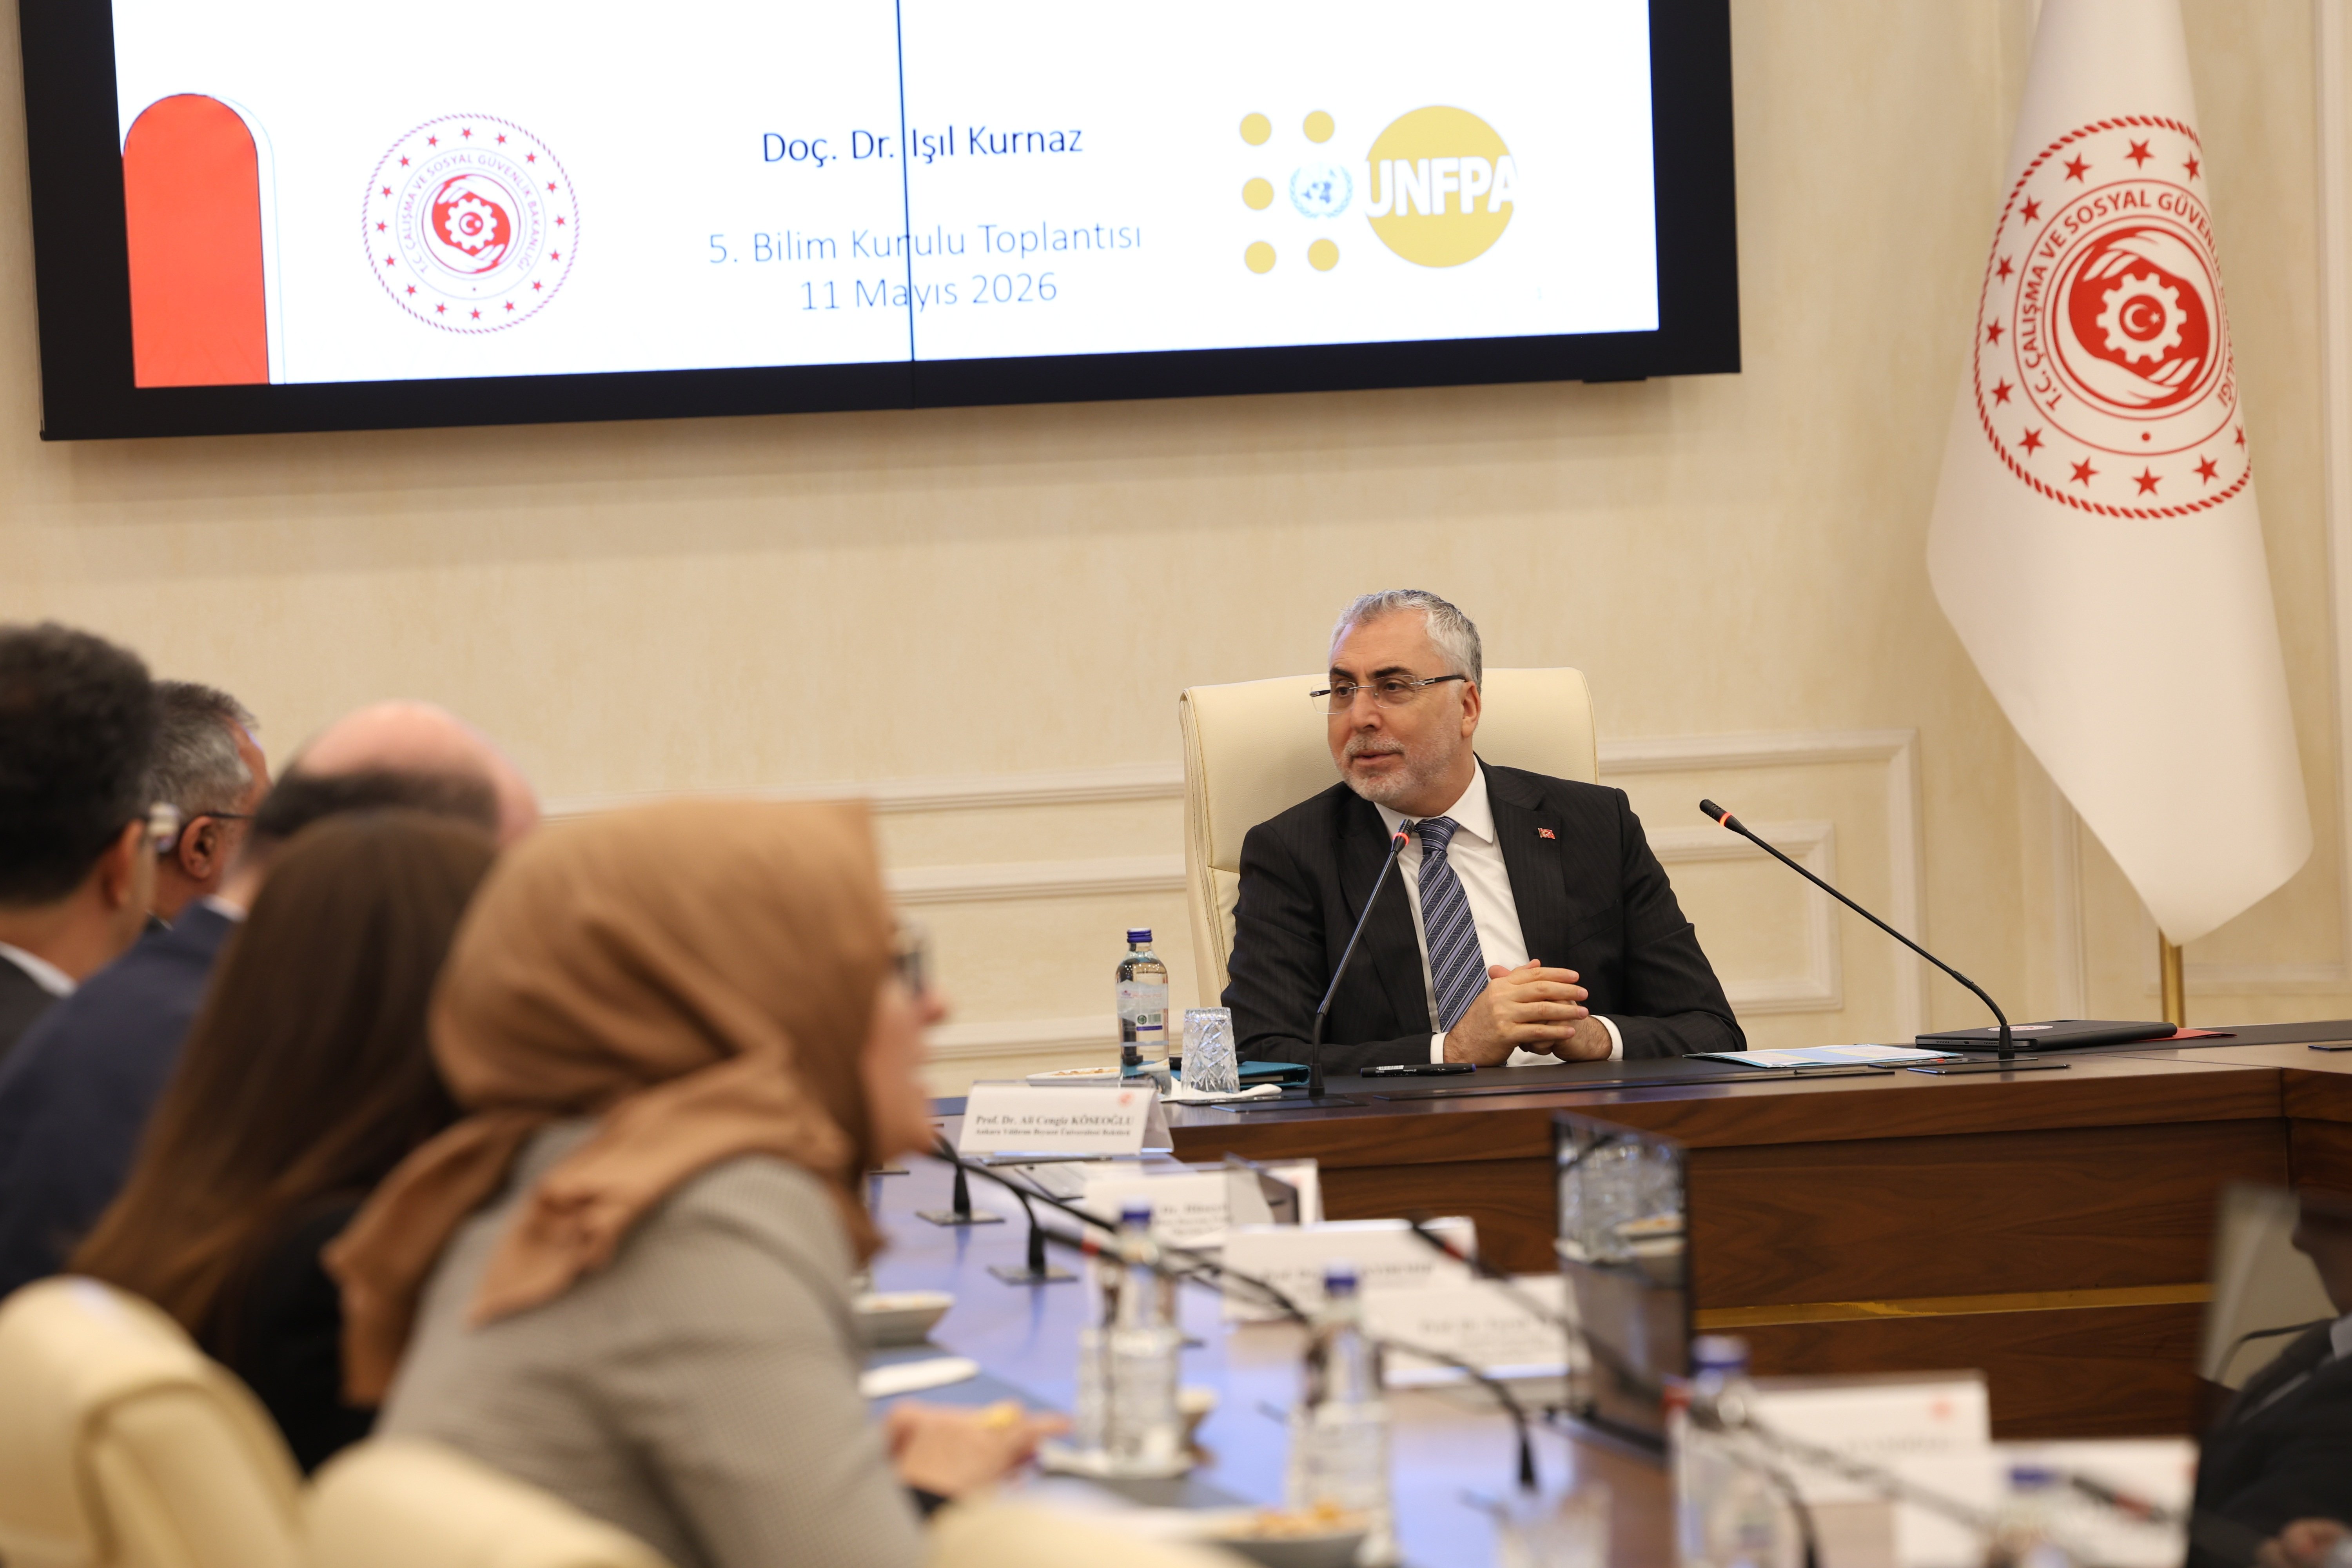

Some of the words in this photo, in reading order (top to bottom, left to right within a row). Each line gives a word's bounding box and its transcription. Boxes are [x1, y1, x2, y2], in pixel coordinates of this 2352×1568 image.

[763, 132, 837, 167] Doç.
[851, 130, 894, 159] Dr.
[913, 125, 955, 164] Işıl
[969, 125, 1084, 155] Kurnaz
[413, 174, 427, 190] VE
[426, 154, 472, 176] SOSYAL
[1363, 154, 1518, 218] UNFPA
[2064, 189, 2152, 235] SOSYAL
[709, 233, 738, 264] 5.
[754, 229, 837, 263] Bilim
[853, 225, 965, 258] Kurulu
[977, 220, 1141, 259] Toplantısı
[2040, 230, 2067, 258] VE
[800, 280, 840, 310] 11
[856, 279, 959, 313] Mayıs
[972, 271, 1058, 304] 2026
[2022, 266, 2048, 368] ÇALIŞMA
[2035, 370, 2063, 411] T.C.
